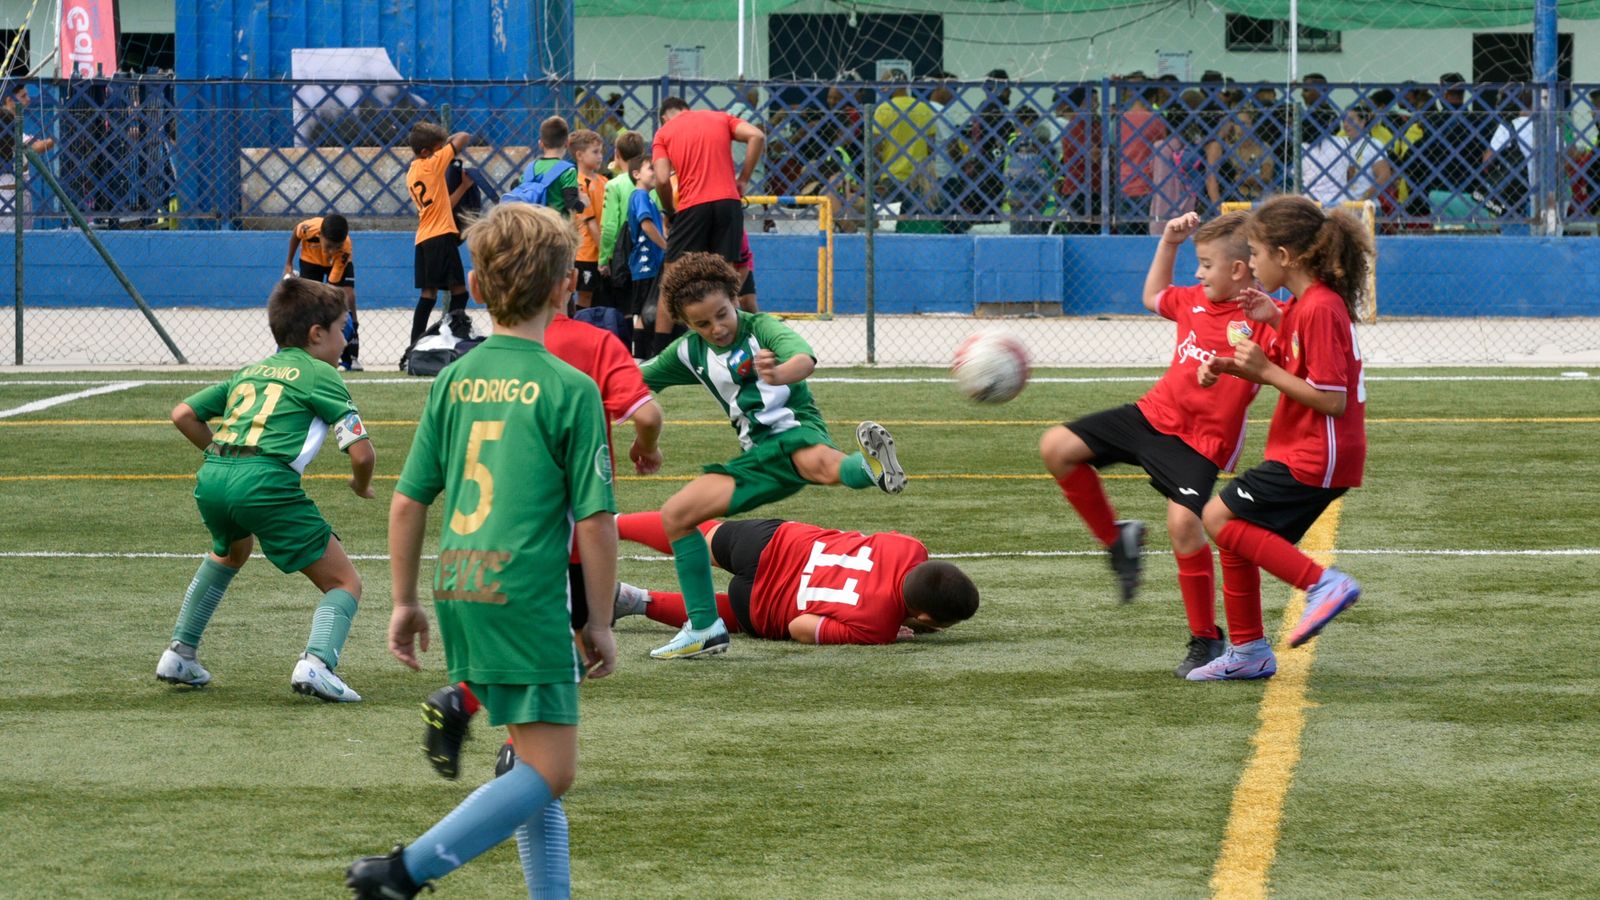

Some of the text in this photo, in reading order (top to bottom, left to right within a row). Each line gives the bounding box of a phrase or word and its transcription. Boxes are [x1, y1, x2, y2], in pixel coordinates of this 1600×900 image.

[242, 365, 301, 382] TONIO
[212, 383, 285, 446] 21
[450, 421, 505, 536] 5
[796, 540, 874, 611] 11
